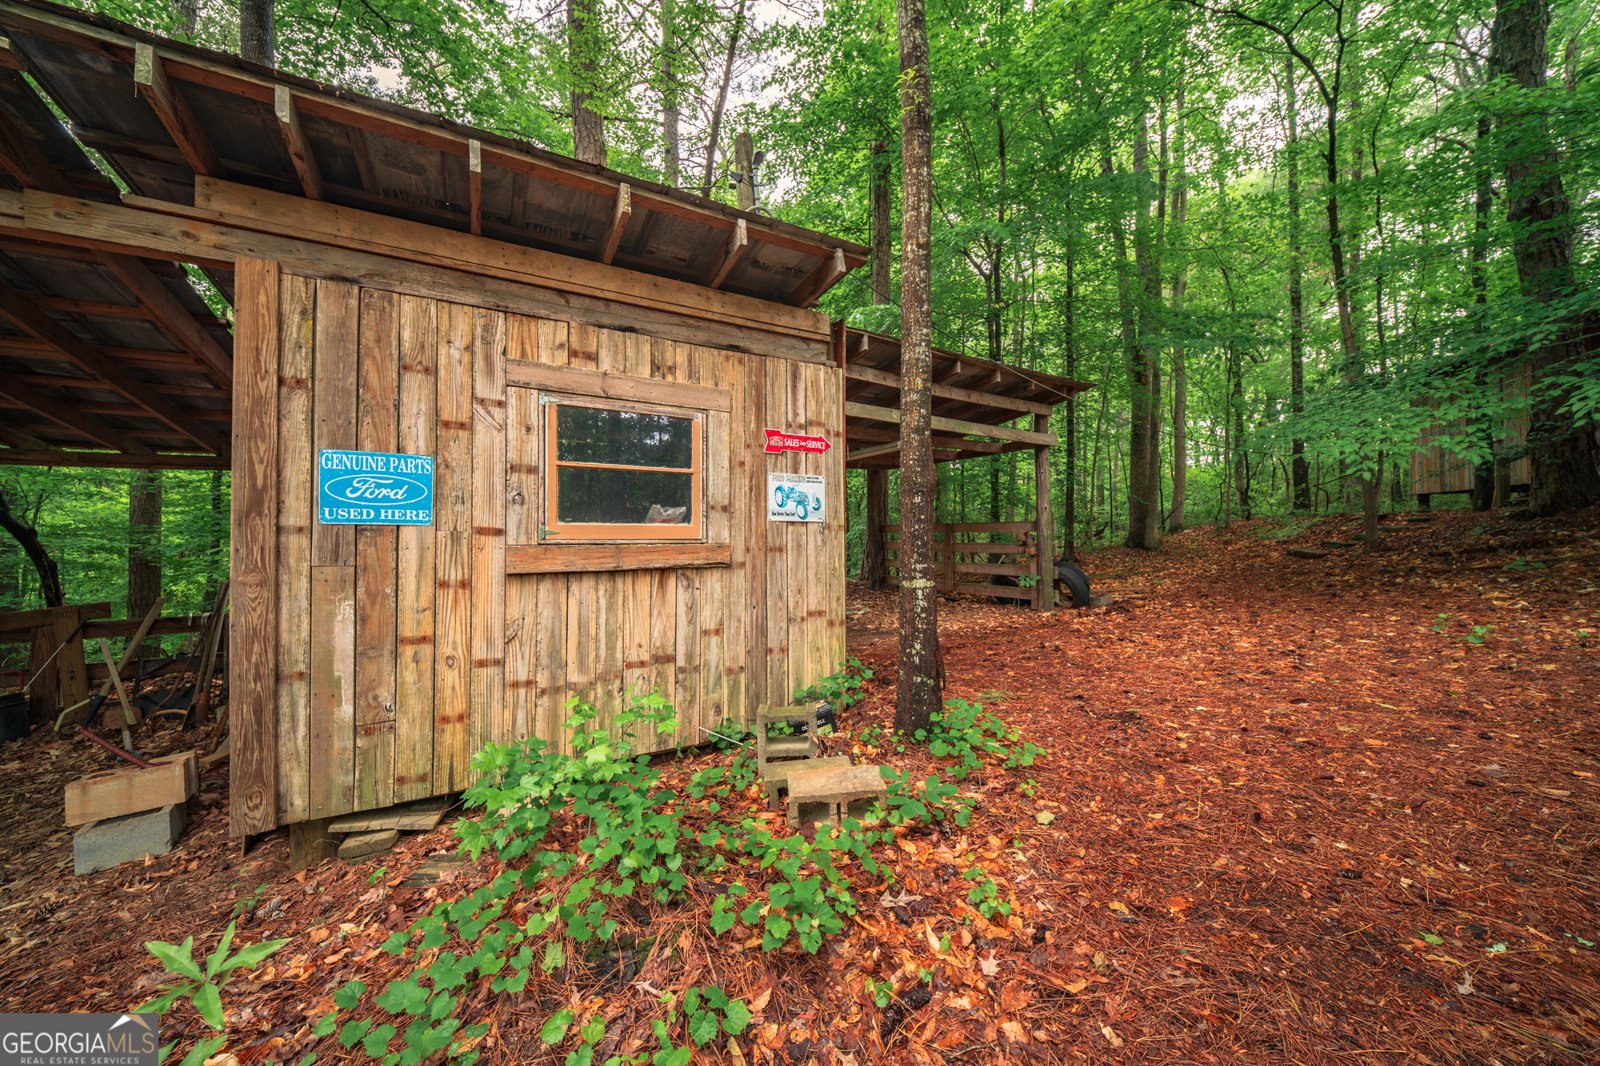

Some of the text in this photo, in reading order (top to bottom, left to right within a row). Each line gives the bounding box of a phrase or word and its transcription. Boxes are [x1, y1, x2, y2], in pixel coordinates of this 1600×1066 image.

[784, 438, 800, 447] SALES
[806, 441, 826, 449] SERVICE
[322, 453, 432, 474] GENUINE PARTS
[346, 477, 408, 499] Ford
[323, 508, 430, 520] USED HERE
